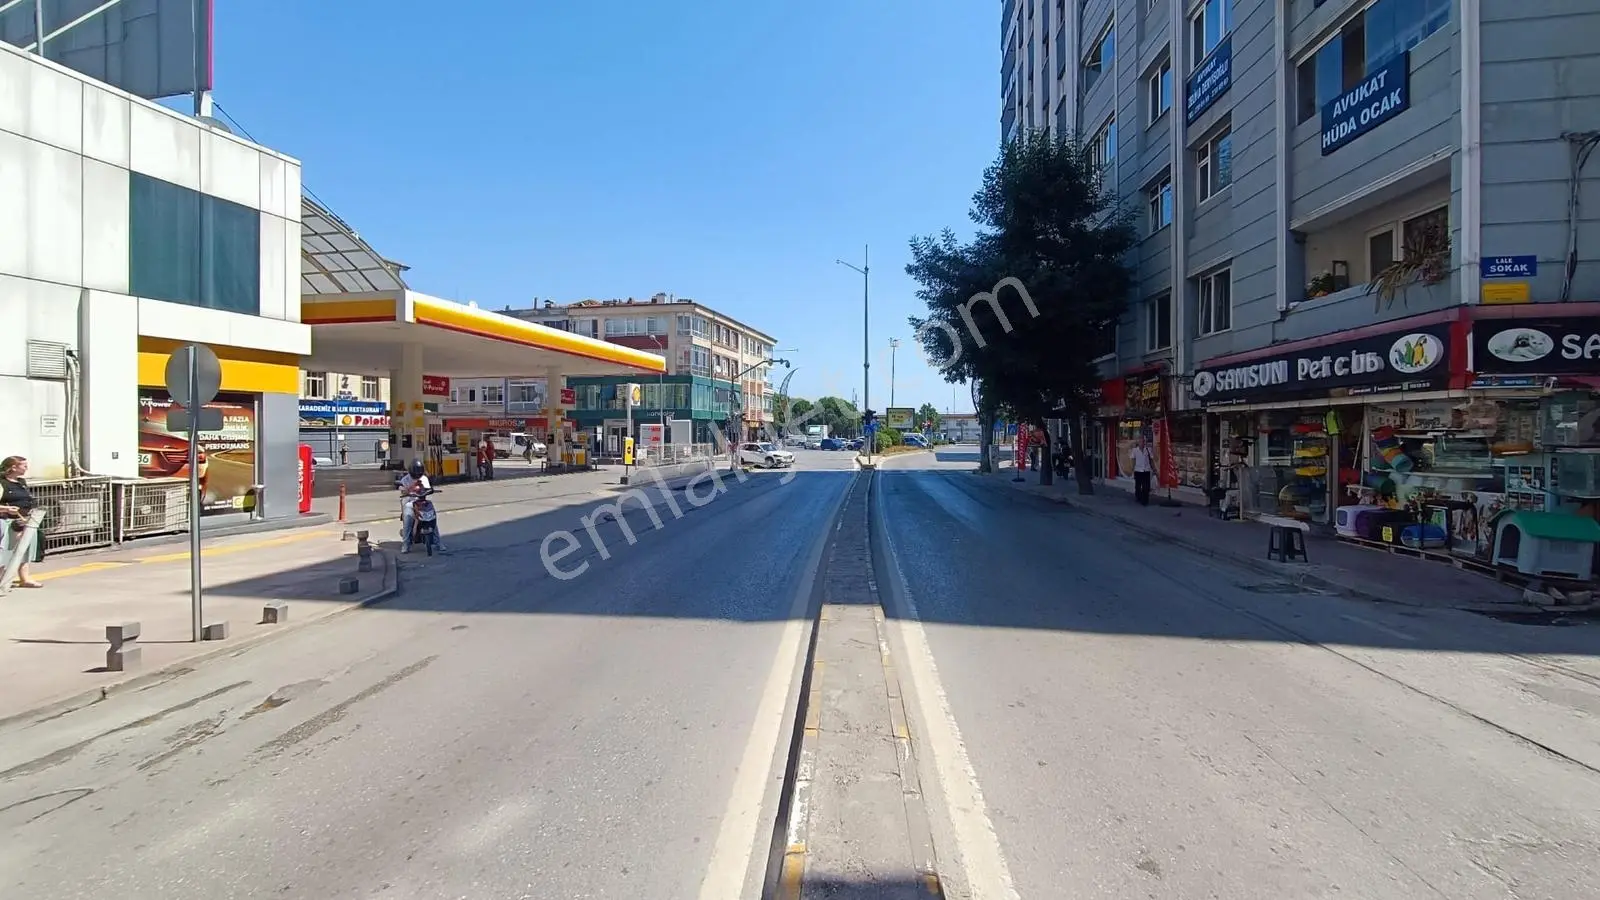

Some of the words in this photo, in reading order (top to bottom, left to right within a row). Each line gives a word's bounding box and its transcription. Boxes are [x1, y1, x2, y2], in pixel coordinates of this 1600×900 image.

[1332, 70, 1388, 119] AVUKAT
[1322, 118, 1357, 149] HÜDA
[1360, 88, 1402, 126] OCAK
[1489, 264, 1528, 273] SOKAK
[1216, 360, 1289, 392] SAMSUN
